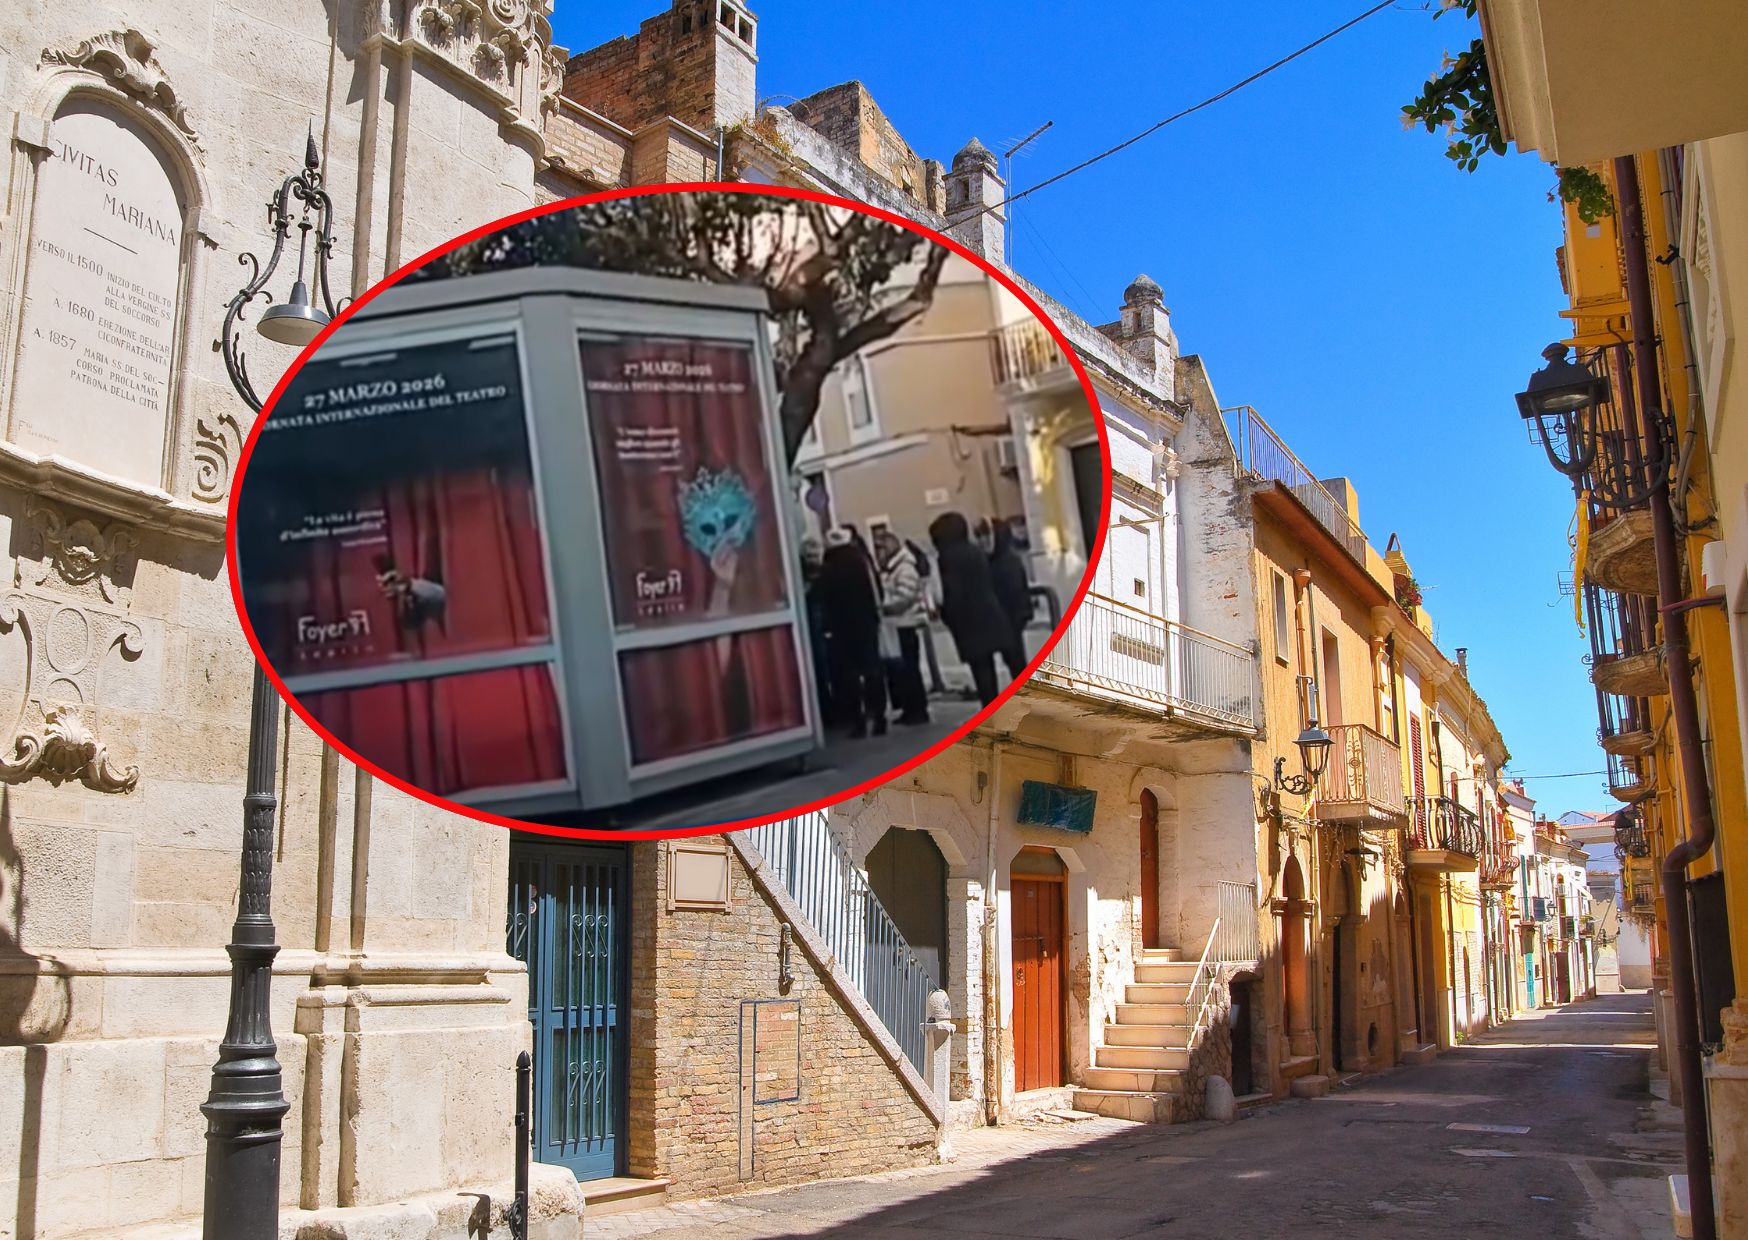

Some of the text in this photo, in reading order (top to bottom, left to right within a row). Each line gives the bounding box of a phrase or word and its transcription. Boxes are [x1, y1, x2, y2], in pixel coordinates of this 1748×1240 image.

[103, 193, 176, 246] MARIANA
[36, 239, 172, 309] VERSO IL 1500 INIZIO DEL CULTO
[68, 300, 95, 322] 1680
[98, 316, 137, 341] EREZIONE
[104, 296, 160, 329] DEL SOCCORSO
[106, 285, 126, 301] ALLA
[128, 294, 159, 316] VERGINE
[48, 330, 77, 351] 1857
[83, 347, 109, 366] MARIA
[124, 363, 140, 378] DEL
[69, 369, 108, 393] PATRONA
[110, 385, 136, 403] DELLA
[76, 358, 159, 399] CORSO PROCLAMATA
[304, 373, 446, 410] 27 MARZO 2026
[315, 398, 426, 425] INTERNAZIONALE
[428, 394, 454, 409] DEL
[455, 385, 507, 404] TEATRO
